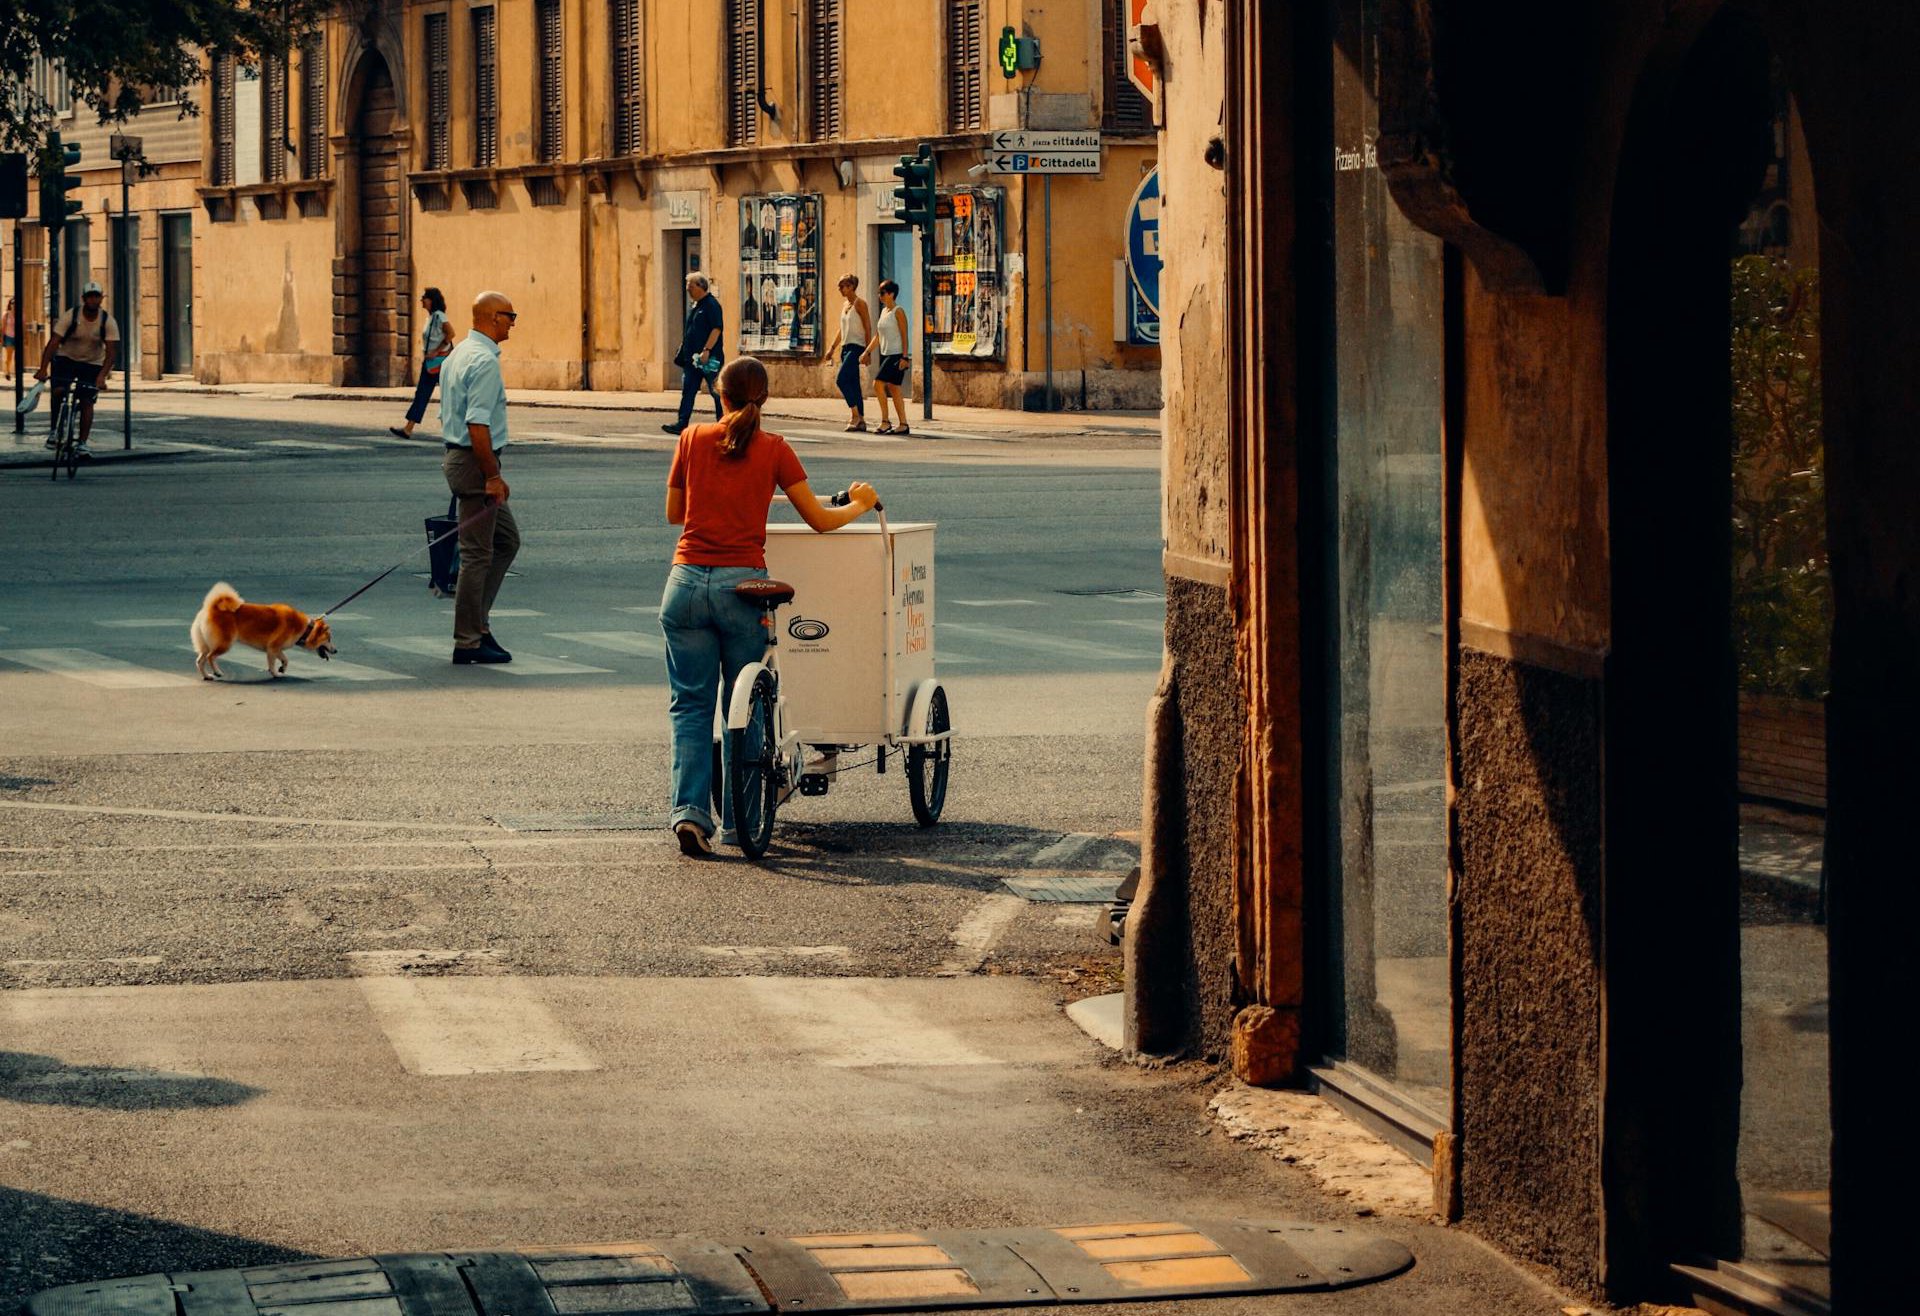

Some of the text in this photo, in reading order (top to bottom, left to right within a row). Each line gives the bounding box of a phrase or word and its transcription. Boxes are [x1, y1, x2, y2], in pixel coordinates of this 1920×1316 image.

[1032, 136, 1098, 146] piazza cittadella
[1040, 158, 1096, 168] Cittadella
[907, 601, 925, 637] Opera
[906, 628, 926, 655] Festival
